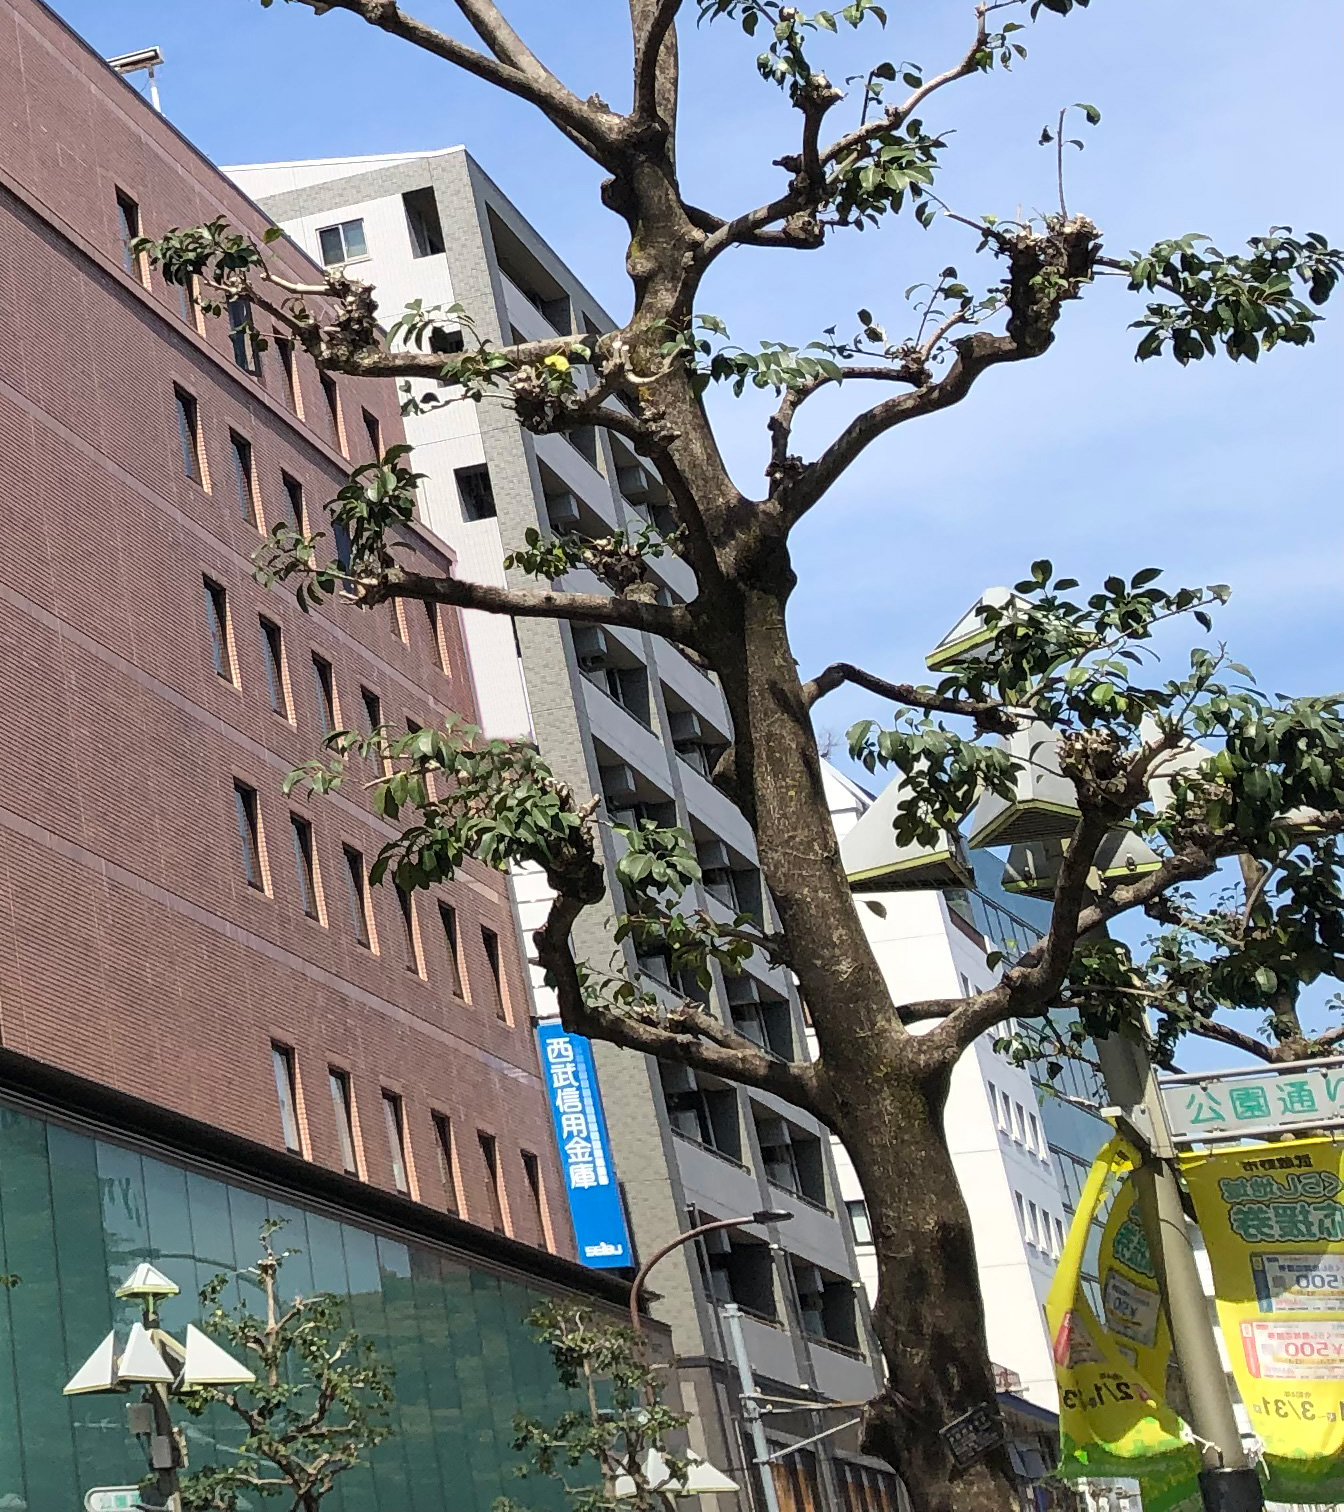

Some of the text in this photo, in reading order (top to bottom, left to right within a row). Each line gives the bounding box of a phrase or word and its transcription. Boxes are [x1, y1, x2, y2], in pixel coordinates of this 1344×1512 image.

[545, 1036, 598, 1190] 西武信用金庫
